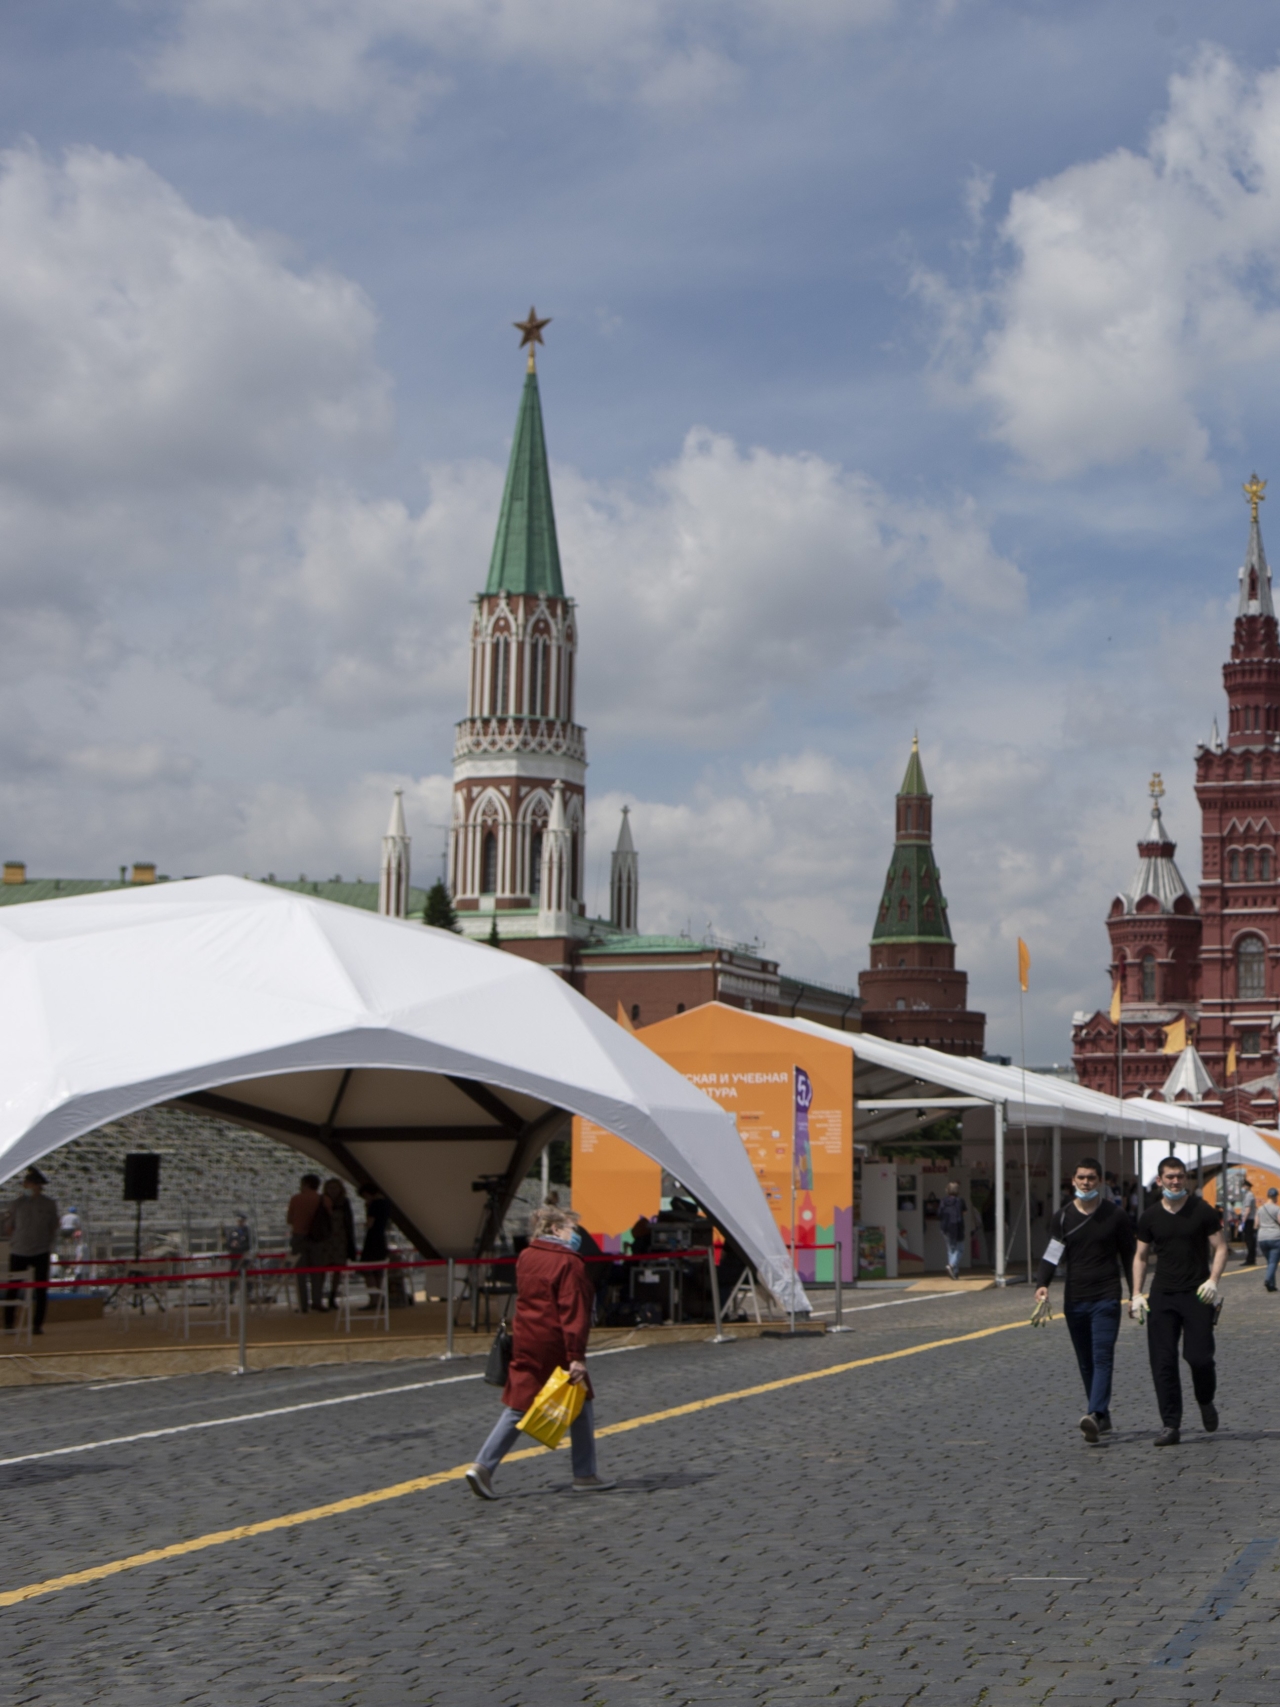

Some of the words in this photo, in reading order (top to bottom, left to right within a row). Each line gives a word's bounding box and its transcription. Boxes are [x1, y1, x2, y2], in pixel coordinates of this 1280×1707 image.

[682, 1073, 717, 1084] СКАЯ
[719, 1073, 729, 1084] И
[731, 1072, 788, 1084] УЧЕБНАЯ
